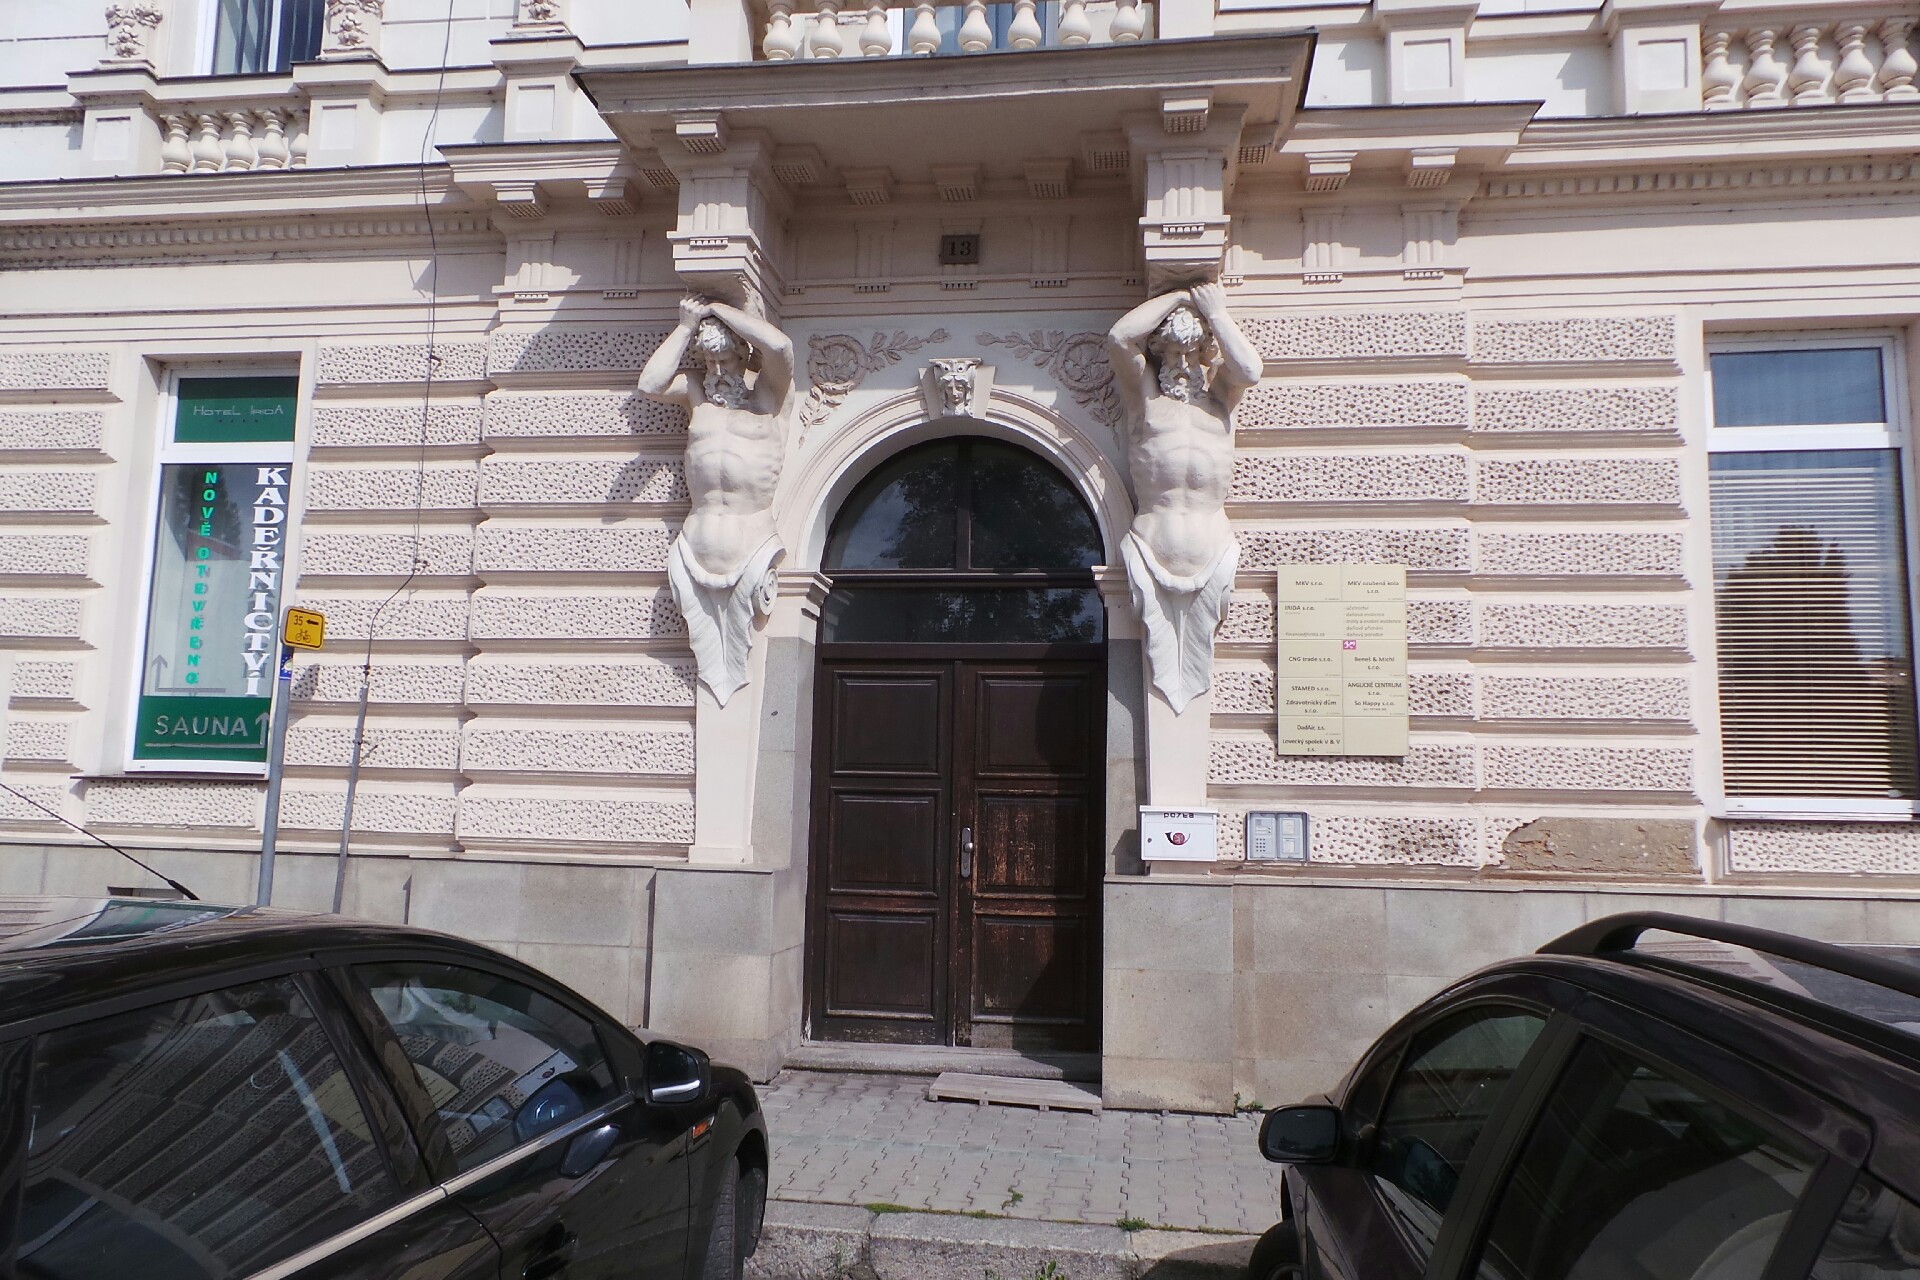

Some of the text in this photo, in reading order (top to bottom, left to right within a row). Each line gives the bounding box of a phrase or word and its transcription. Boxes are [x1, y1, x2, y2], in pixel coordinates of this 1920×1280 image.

[948, 240, 972, 256] 13
[185, 471, 217, 685] NOVĚ OTEVŘENO
[240, 467, 288, 696] KADEŘNICTVÍ
[293, 615, 304, 626] 35
[154, 715, 249, 737] SAUNA
